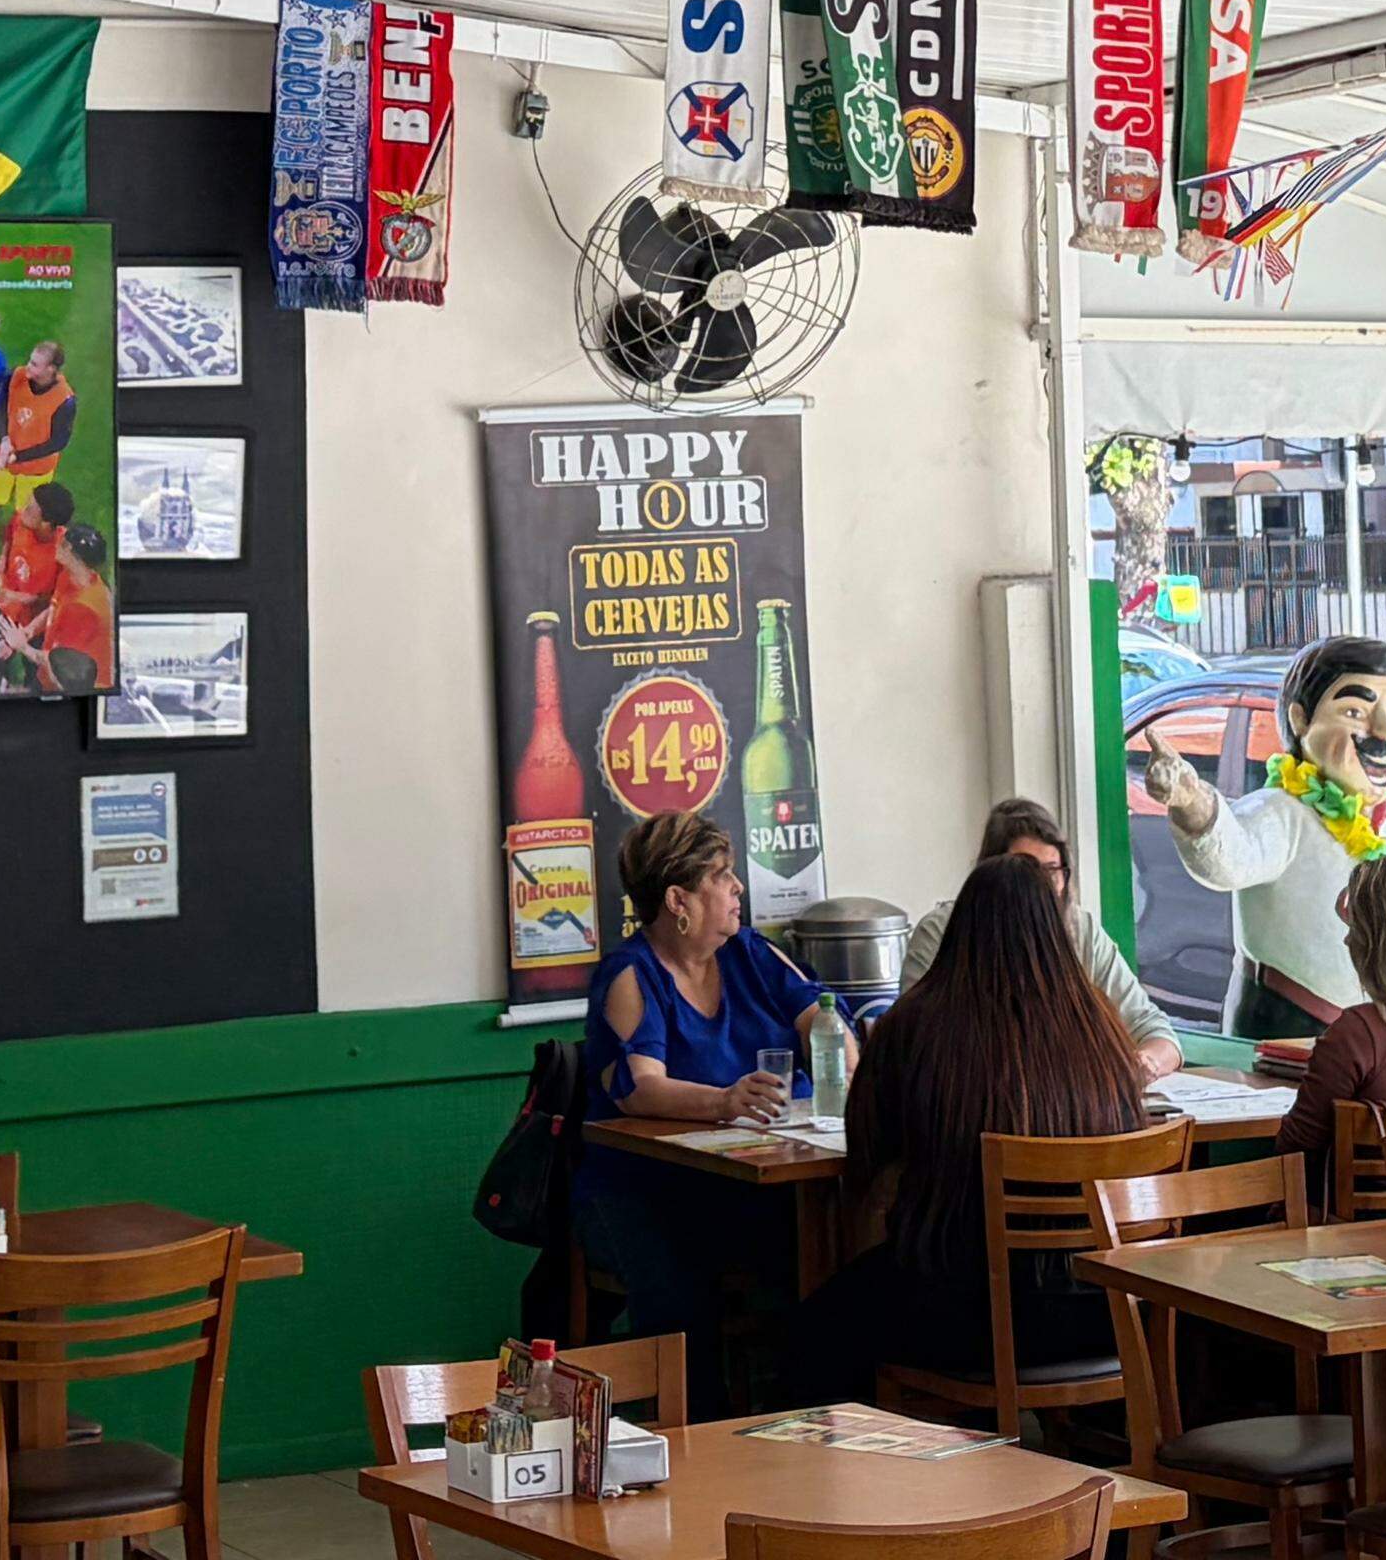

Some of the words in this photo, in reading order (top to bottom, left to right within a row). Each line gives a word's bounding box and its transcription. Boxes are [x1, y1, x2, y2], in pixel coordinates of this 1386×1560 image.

[280, 27, 325, 117] PORTO
[539, 430, 748, 483] HAPPY
[596, 479, 764, 532] HOUR
[579, 549, 686, 590] TODAS
[694, 546, 730, 584] AS
[584, 593, 730, 638] CERVEJAS
[613, 651, 654, 667] EXCETO
[634, 702, 656, 717] POR
[515, 828, 584, 843] ANTARCTICA
[515, 881, 592, 909] ORIGINAL
[514, 1462, 547, 1486] 05
